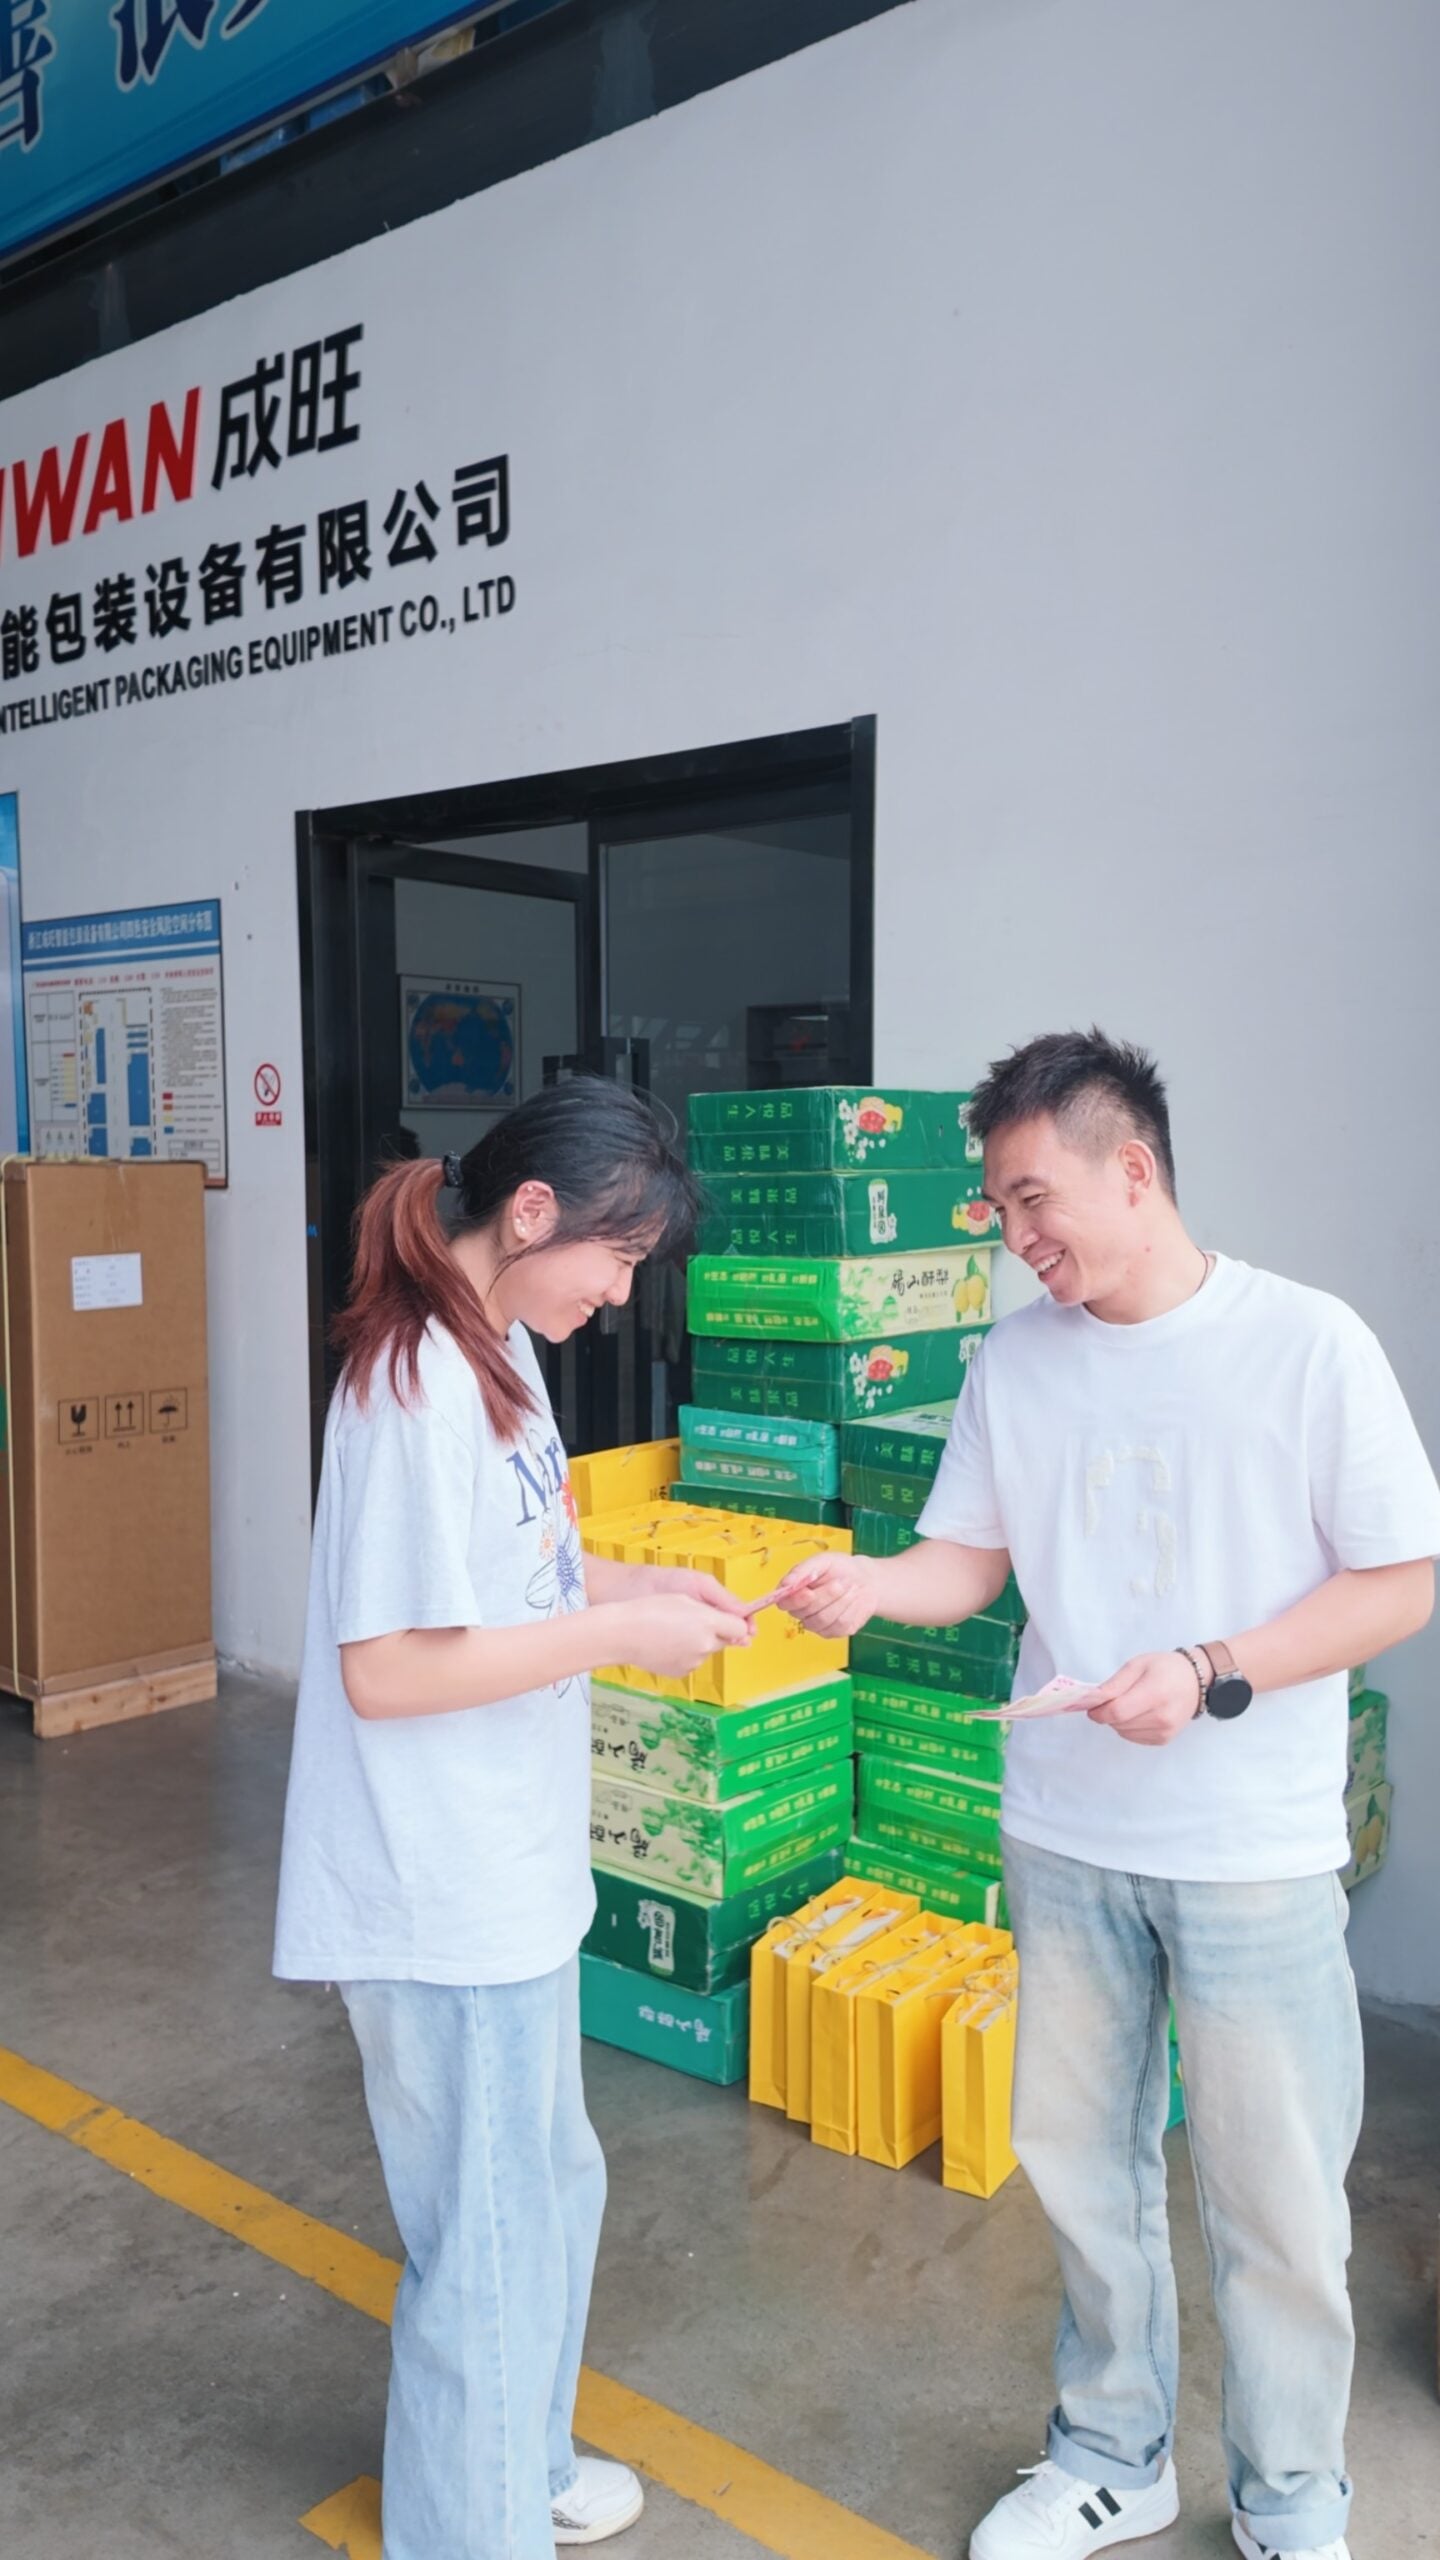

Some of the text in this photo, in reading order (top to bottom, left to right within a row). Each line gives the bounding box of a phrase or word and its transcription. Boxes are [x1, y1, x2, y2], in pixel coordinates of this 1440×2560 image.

[0, 386, 201, 560] WAN
[211, 323, 363, 491] 成旺
[1, 454, 511, 680] 能包装设备有限公司
[115, 646, 243, 706] PACKAGING
[249, 606, 394, 674] EQUIPMENT
